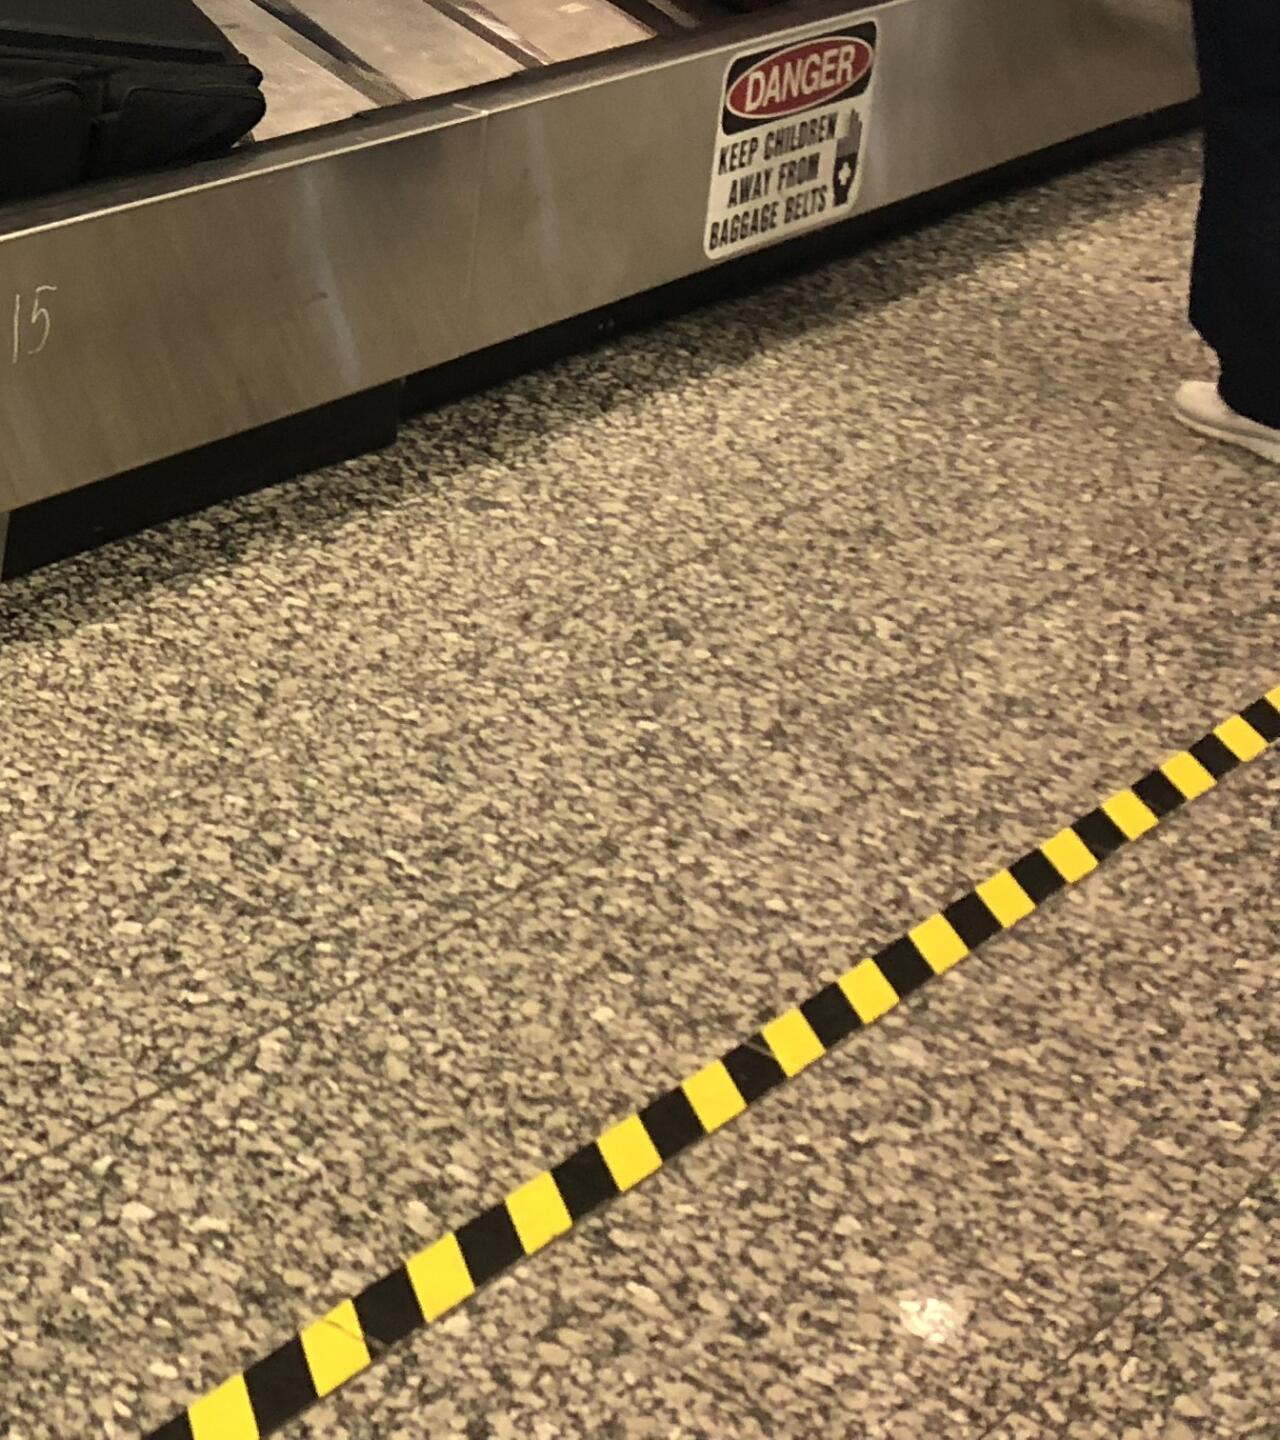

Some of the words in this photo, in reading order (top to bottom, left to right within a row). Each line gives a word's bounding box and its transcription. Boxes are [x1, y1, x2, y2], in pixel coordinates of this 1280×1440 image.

[744, 45, 856, 112] DANGER
[718, 137, 758, 176] KEEP
[763, 113, 838, 161] CHILDREN
[727, 166, 772, 209] AWAY
[777, 152, 820, 194] FROM
[709, 204, 778, 250] BAGGAGE
[783, 185, 828, 224] BELTS
[12, 285, 58, 364] 15
